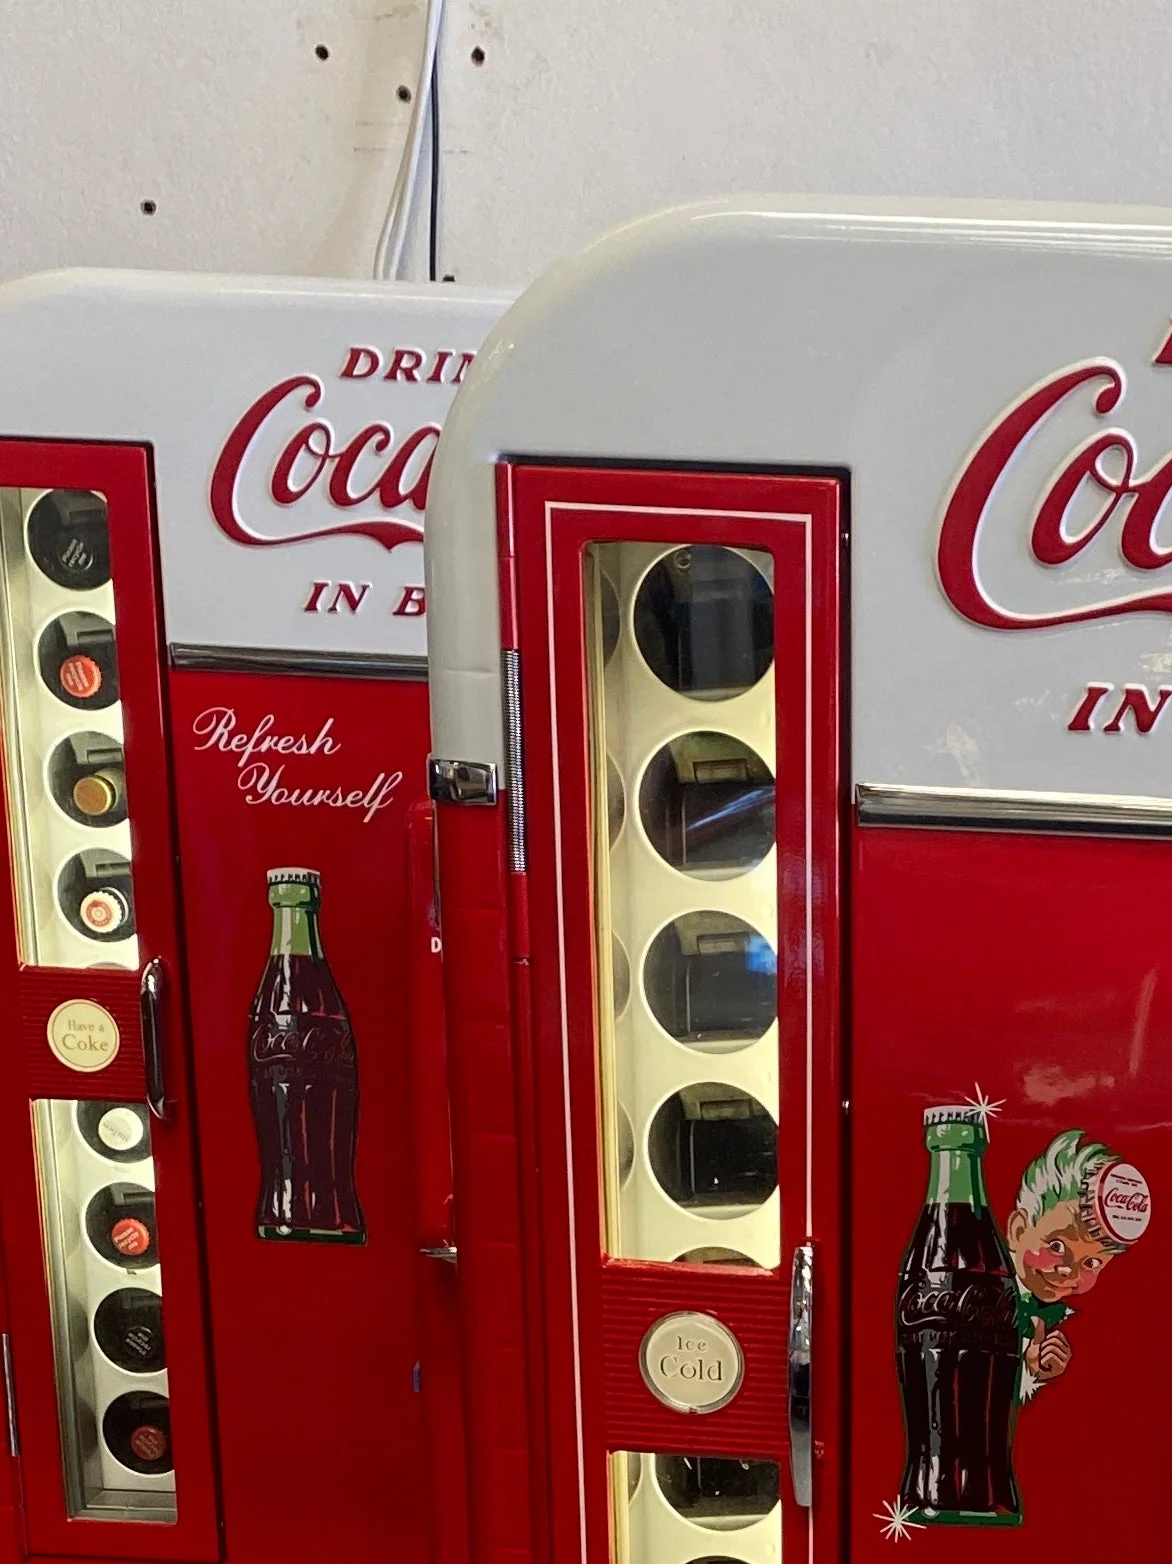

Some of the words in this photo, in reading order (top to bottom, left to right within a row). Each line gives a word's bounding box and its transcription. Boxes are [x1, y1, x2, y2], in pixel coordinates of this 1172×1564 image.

[304, 582, 371, 614] IN
[193, 706, 341, 768] Refresh
[237, 763, 403, 822] Yourself
[67, 1019, 95, 1032] Have
[98, 1024, 105, 1032] a
[62, 1033, 109, 1052] Coke
[677, 1335, 707, 1352] Ice
[659, 1357, 724, 1382] Cold
